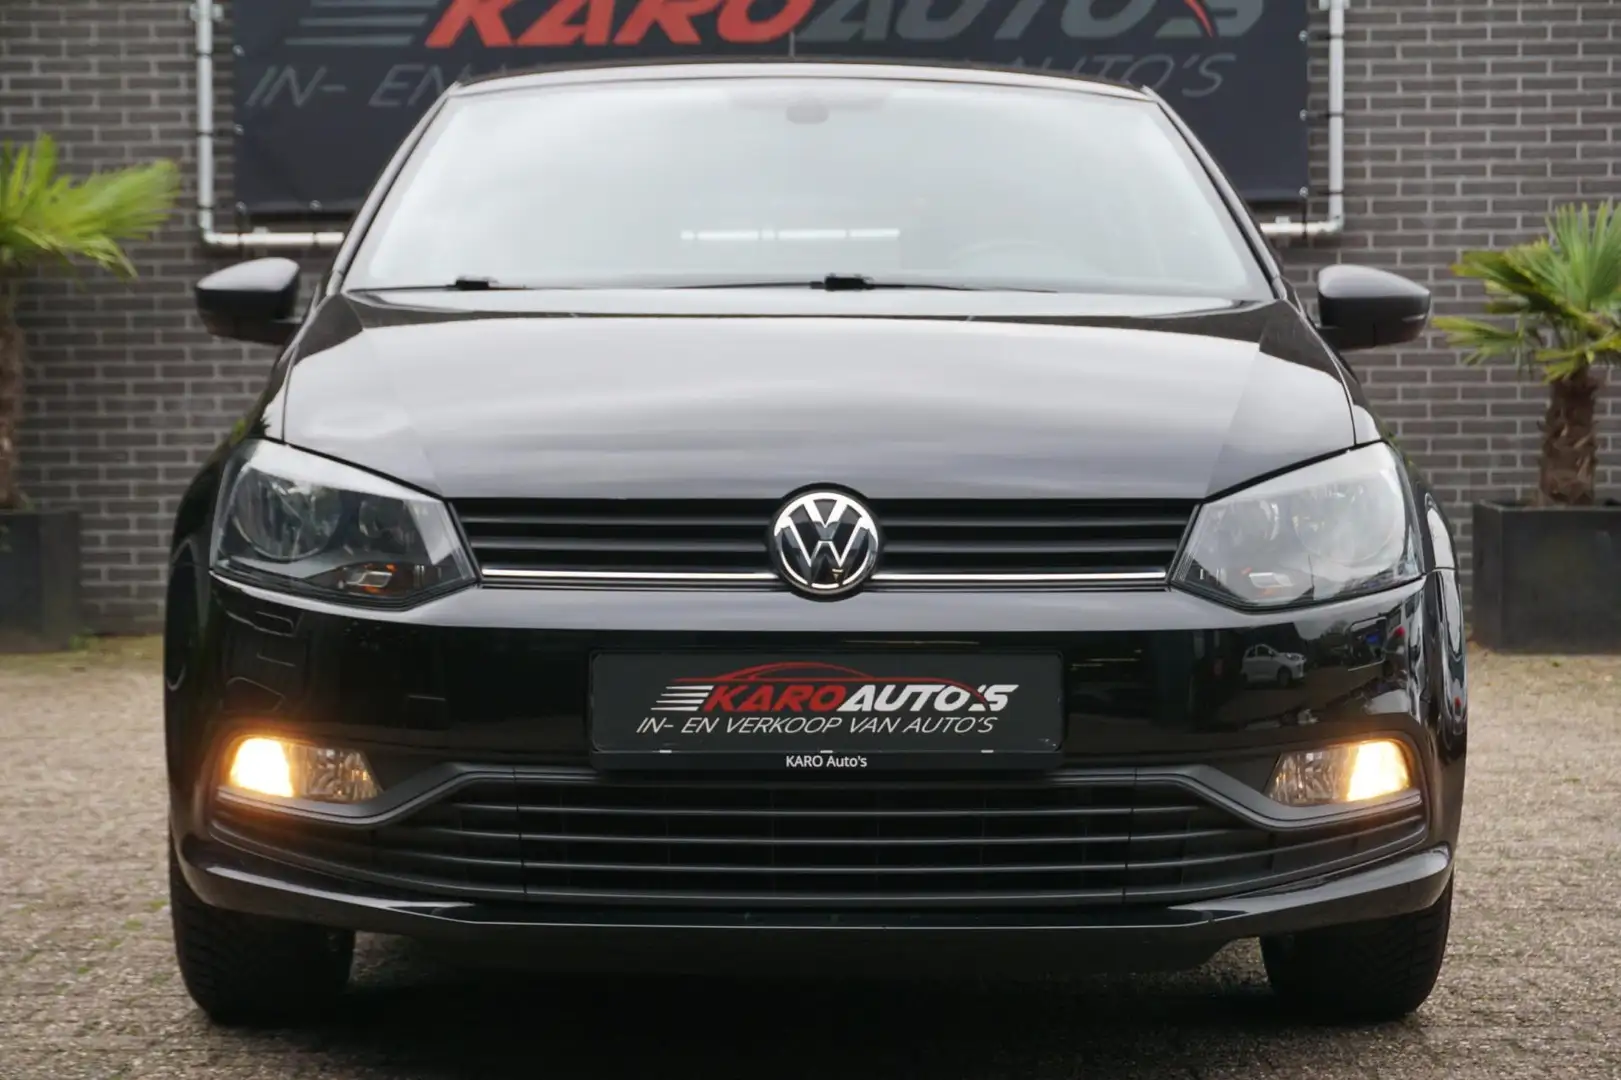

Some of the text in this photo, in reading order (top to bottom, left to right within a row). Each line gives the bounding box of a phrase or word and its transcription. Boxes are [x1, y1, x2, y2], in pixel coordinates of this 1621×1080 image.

[244, 63, 347, 108] IN-
[773, 491, 879, 590] VW
[636, 716, 998, 734] IN- EN VERKOOP VAN AUTO'S
[786, 755, 868, 768] KARO Auto's
